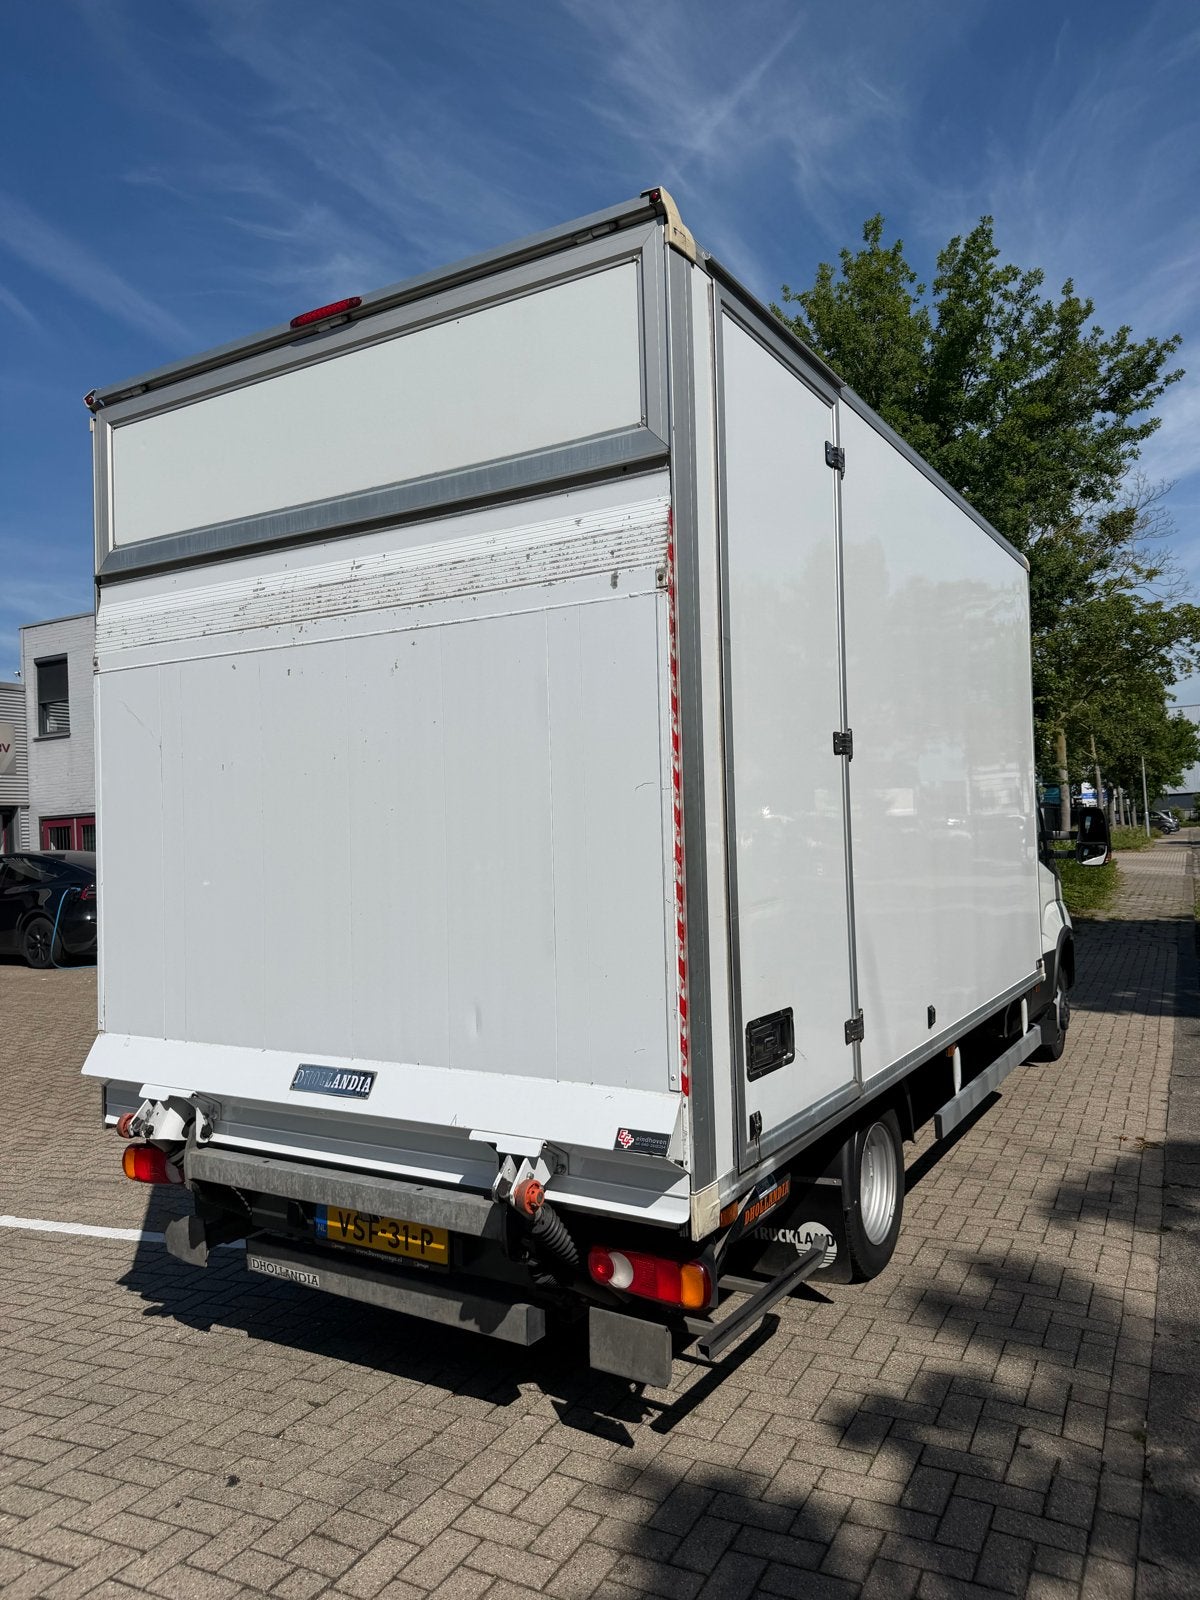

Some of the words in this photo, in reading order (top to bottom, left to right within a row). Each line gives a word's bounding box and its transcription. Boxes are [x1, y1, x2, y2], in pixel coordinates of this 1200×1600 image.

[0, 743, 11, 753] V
[744, 1180, 789, 1226] DHOLLANDIA
[316, 1222, 327, 1233] NL
[338, 1210, 434, 1254] VSF-31-P
[754, 1226, 836, 1248] TRUCKLAD
[252, 1258, 319, 1287] DHOLLANDIA
